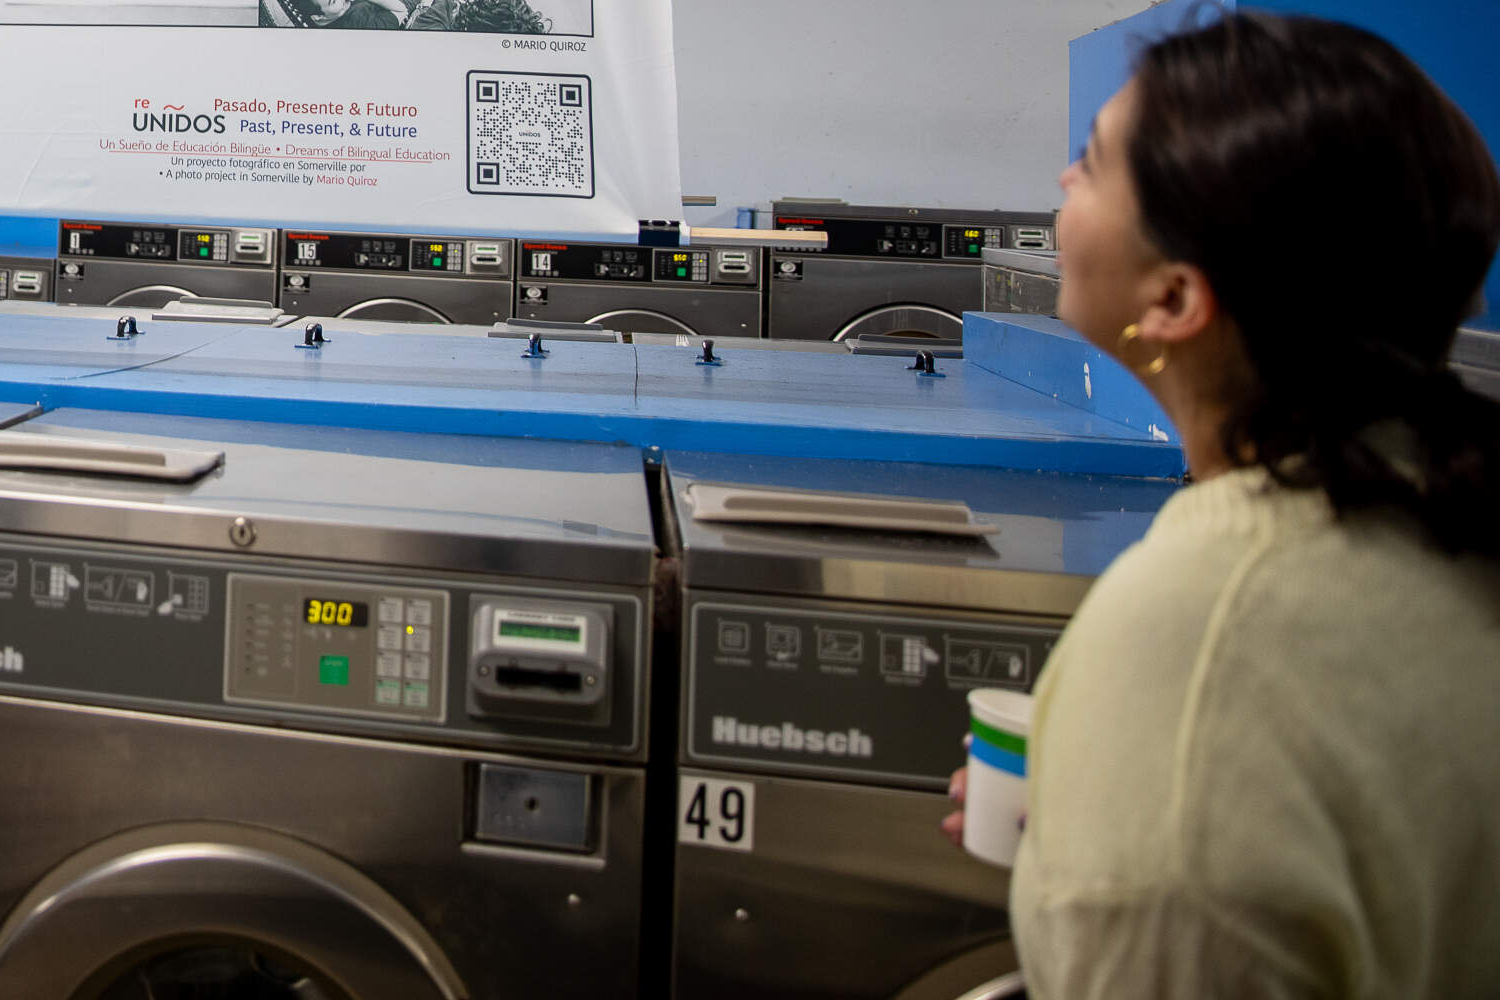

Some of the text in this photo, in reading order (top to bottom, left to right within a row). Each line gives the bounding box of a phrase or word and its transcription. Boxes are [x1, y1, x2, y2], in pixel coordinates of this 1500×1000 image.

[514, 39, 547, 50] MARIO
[550, 40, 587, 51] QUIROZ
[134, 98, 150, 109] re
[214, 98, 418, 118] Pasado, Presente & Futuro
[132, 112, 226, 134] UNIDOS
[240, 119, 417, 138] Past, Present, & Future
[100, 138, 450, 161] Un Sueño de Educación Bilingüe Dreams of Bilingual Education
[171, 156, 365, 173] Un proyecto fotográfico en Somerville por
[165, 169, 378, 187] A photo project in Somerville by Mario Quiroz
[300, 243, 315, 258] 15
[534, 254, 549, 269] 14
[307, 599, 353, 626] 300
[711, 715, 873, 758] Huebsch
[685, 782, 746, 843] 49
